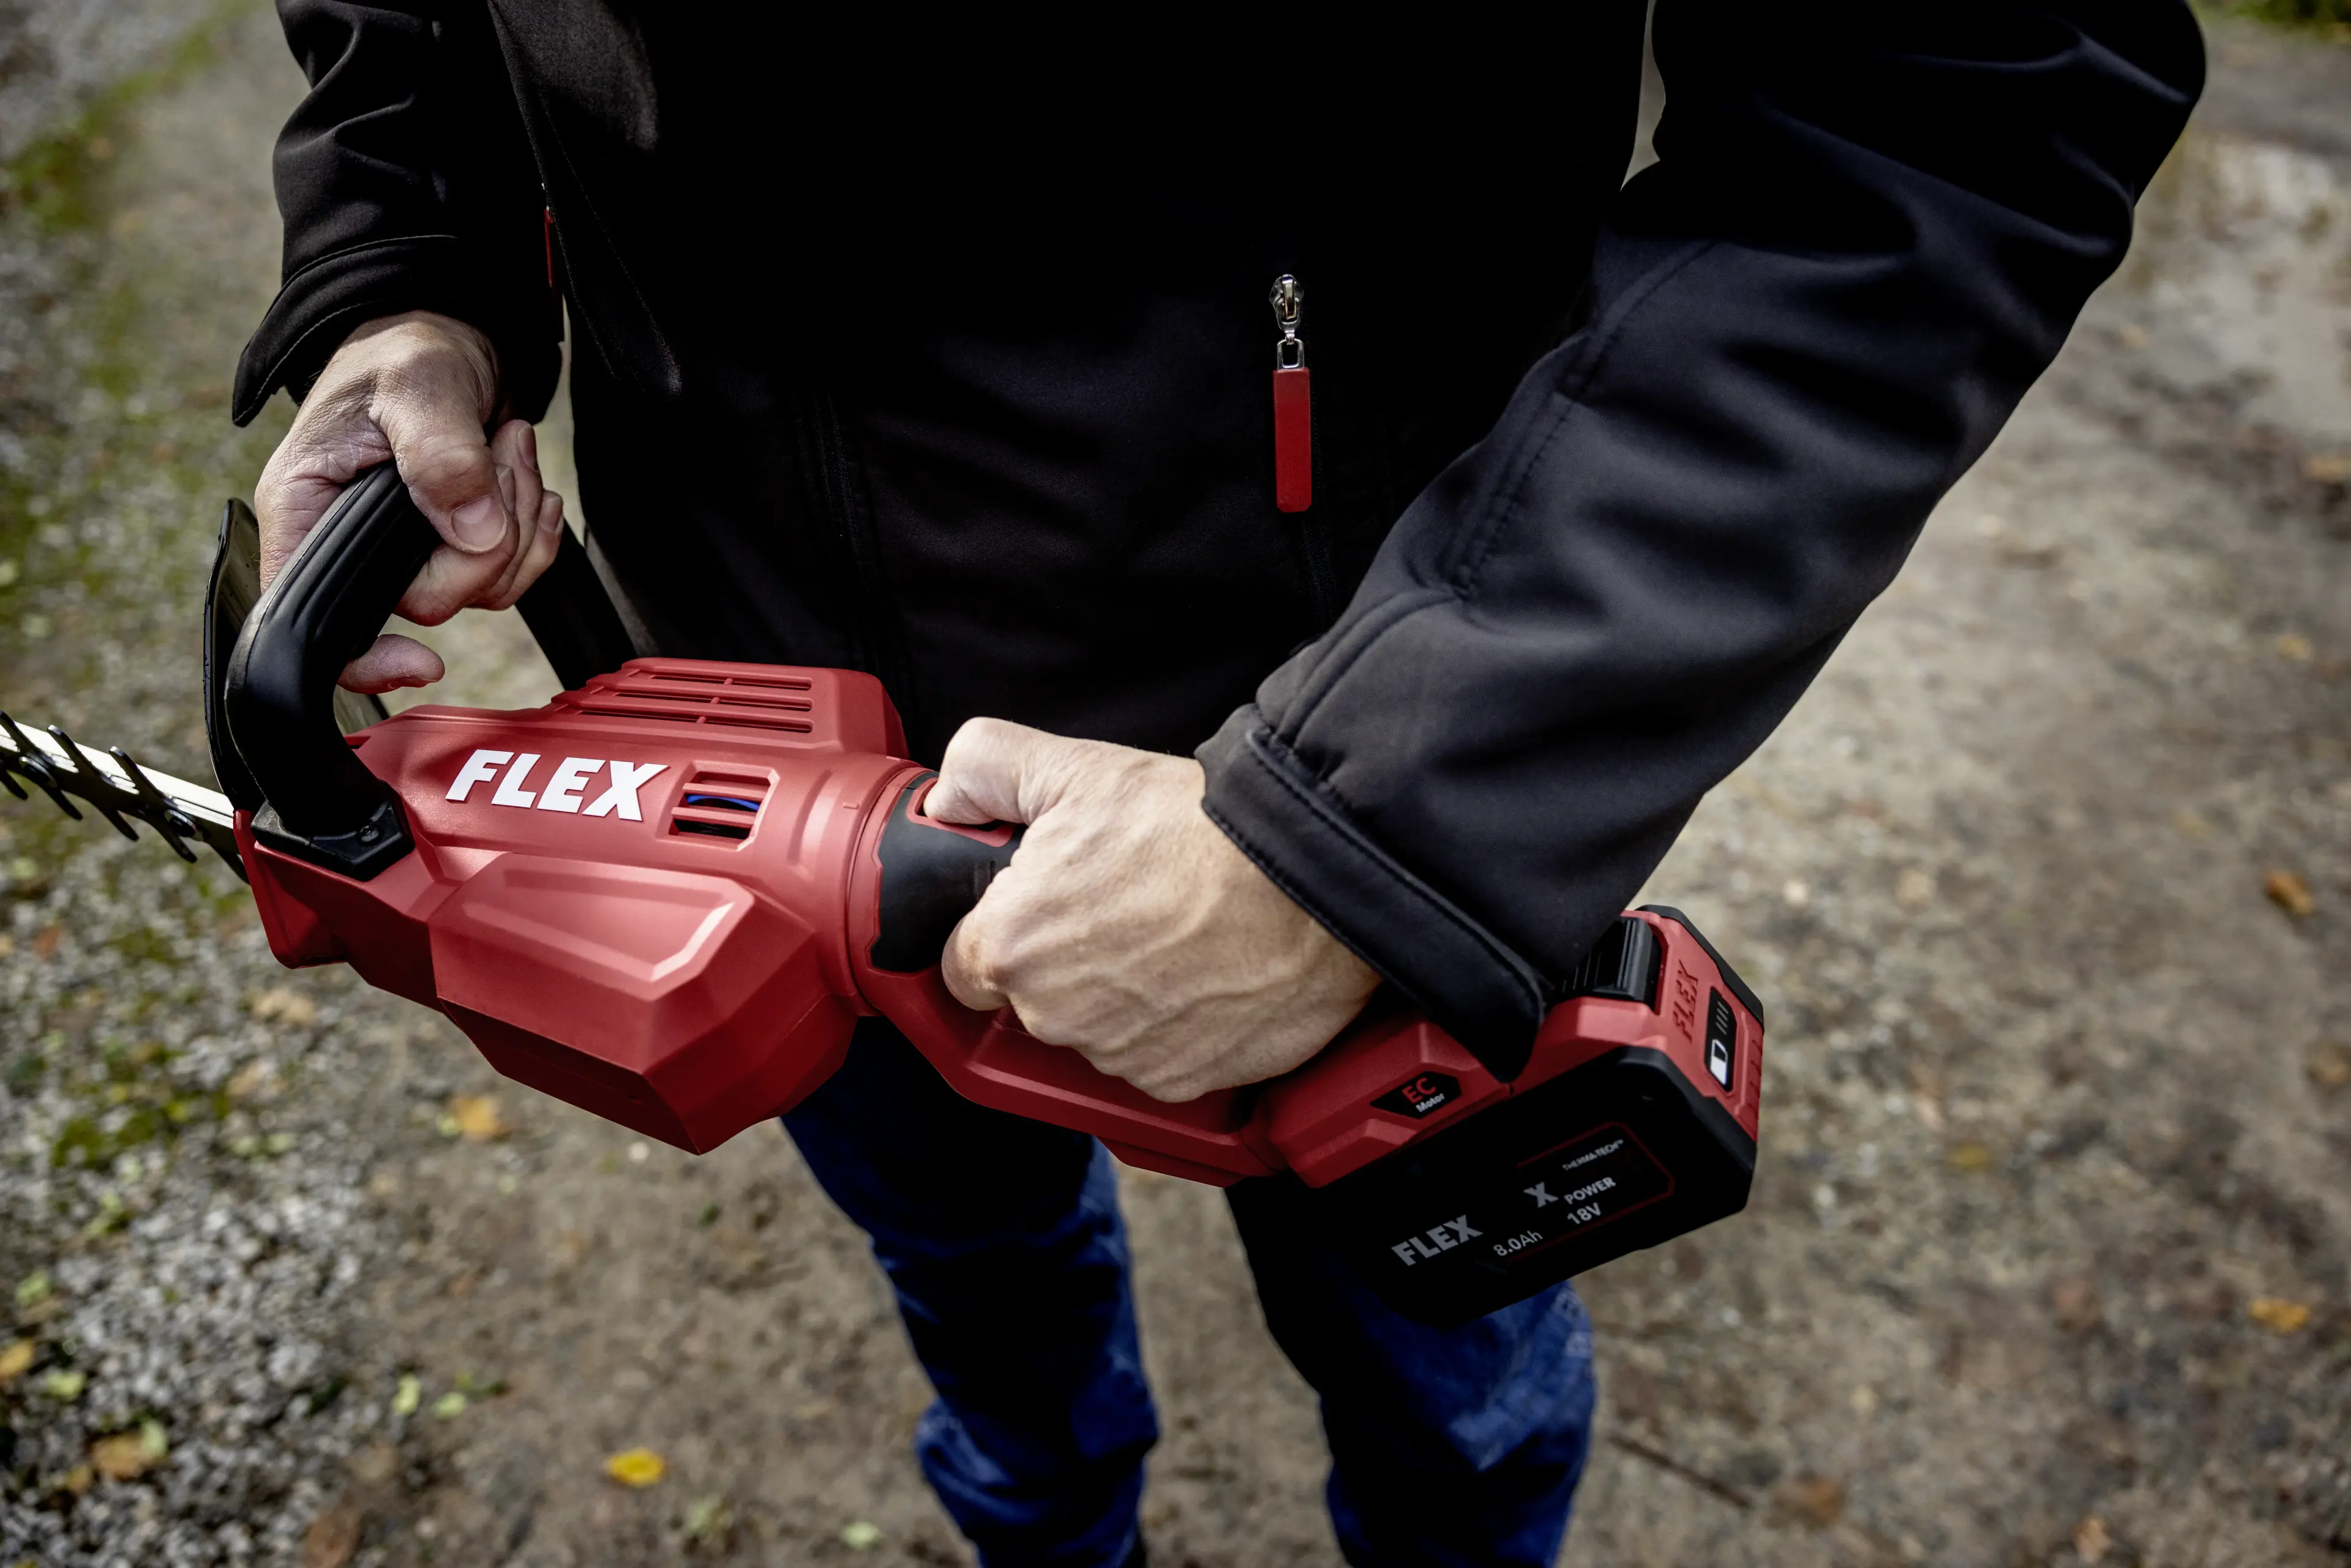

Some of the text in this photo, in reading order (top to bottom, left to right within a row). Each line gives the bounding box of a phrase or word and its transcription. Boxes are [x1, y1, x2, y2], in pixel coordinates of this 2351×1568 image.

[445, 749, 670, 822] FLEX
[1672, 959, 1699, 1043] FLEX
[1401, 1077, 1437, 1104] EC
[1415, 1093, 1445, 1112] Motor
[1523, 1182, 1559, 1208] X
[1564, 1177, 1616, 1205] POWER
[1567, 1202, 1602, 1225] 18V
[1391, 1214, 1483, 1266] FLEX
[1493, 1230, 1543, 1256] 8.0Ah
